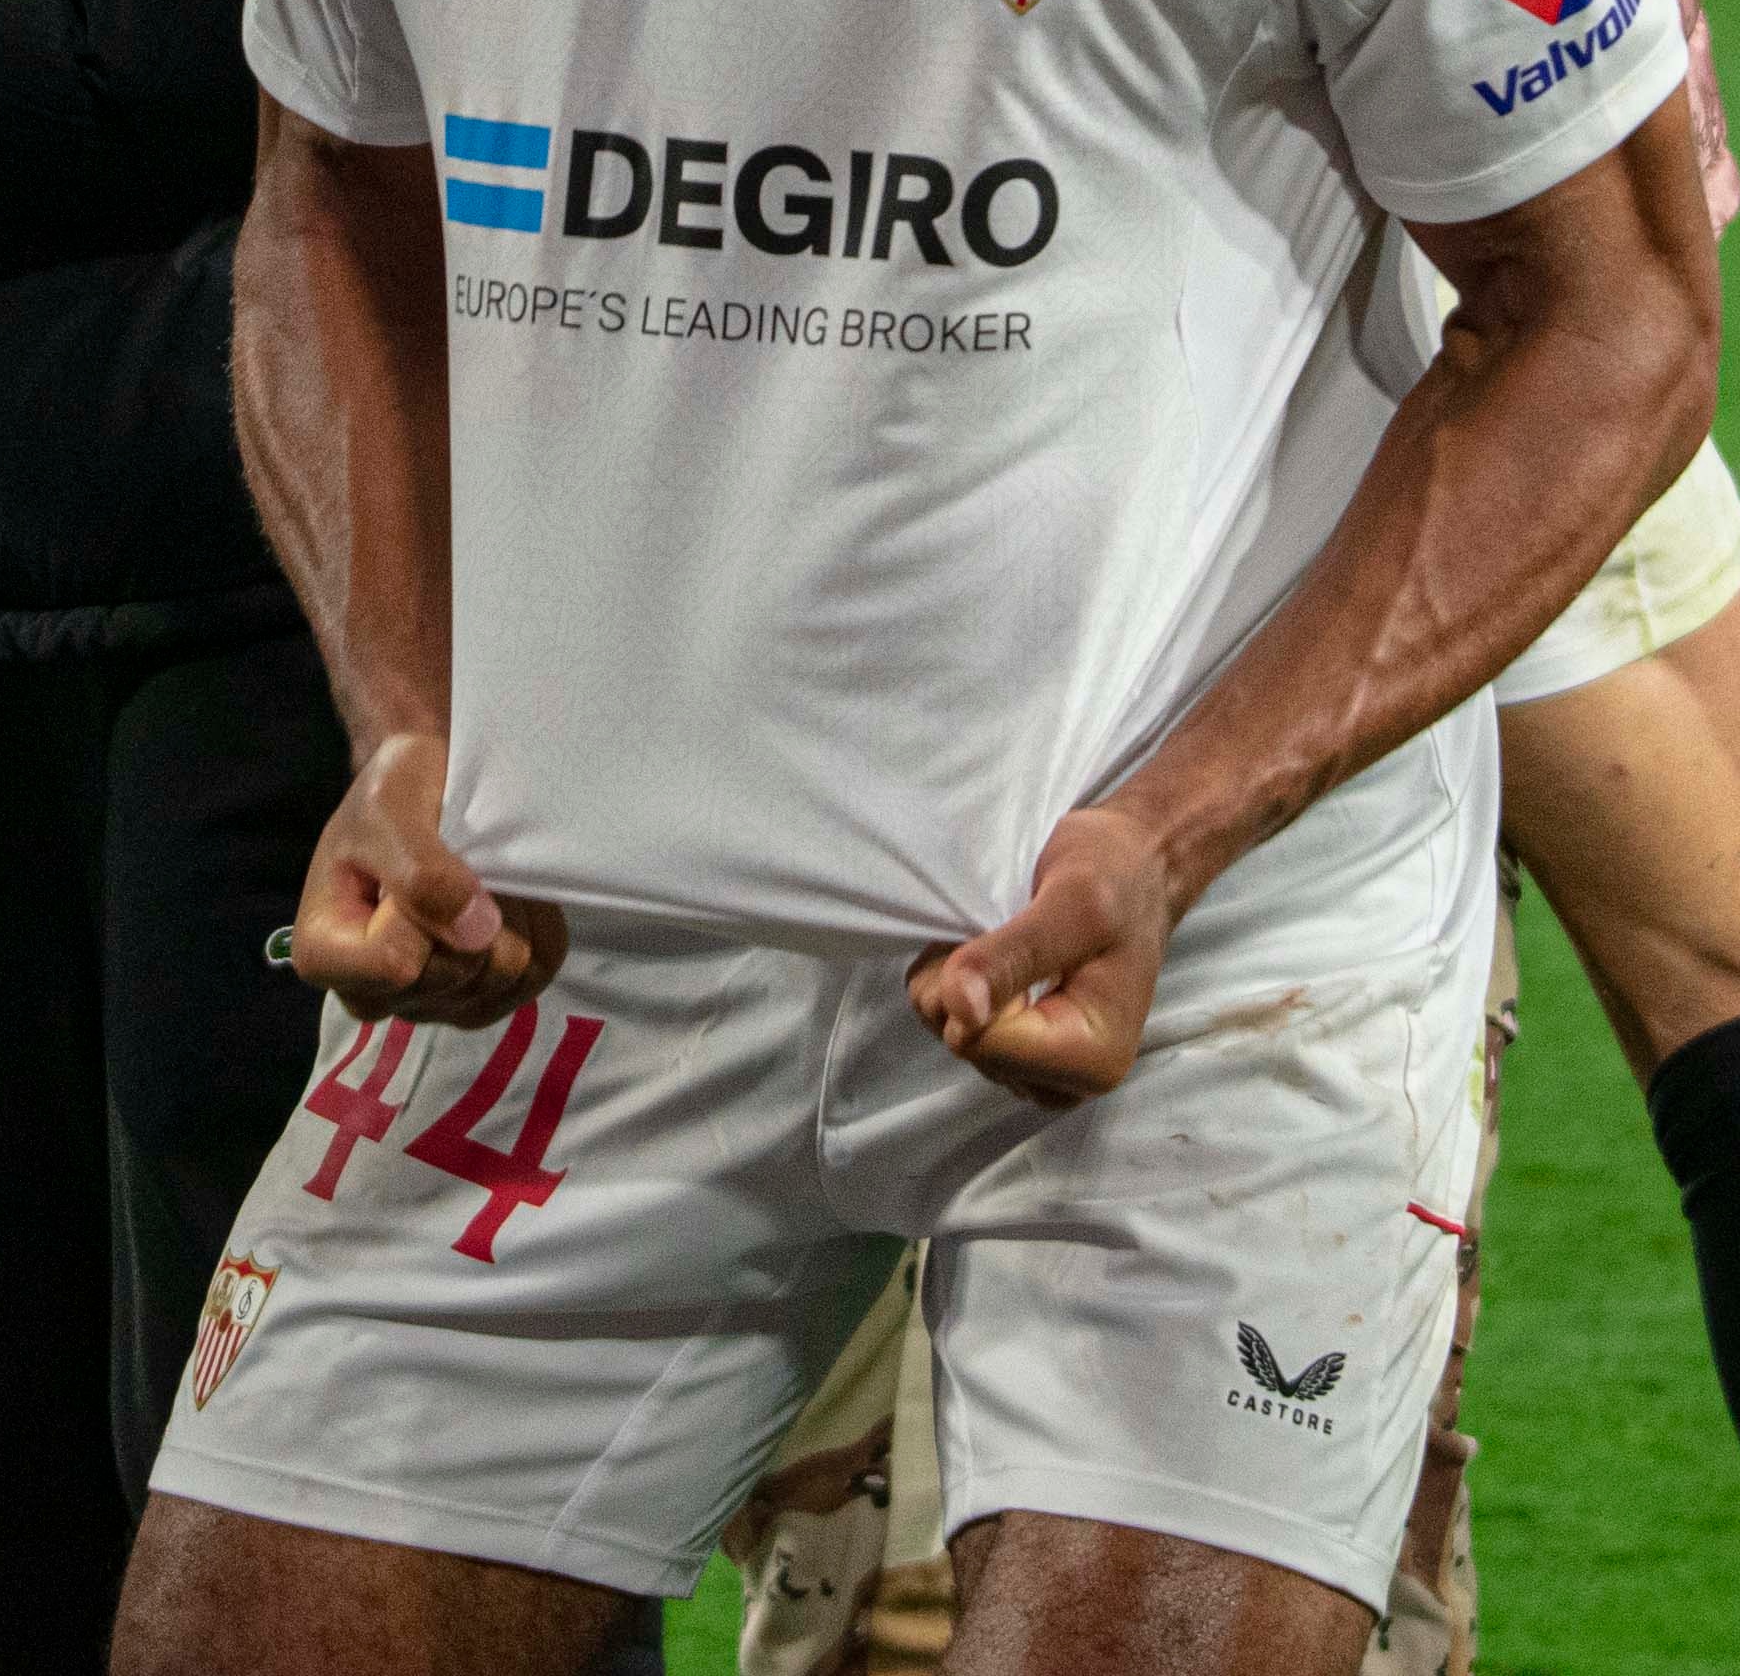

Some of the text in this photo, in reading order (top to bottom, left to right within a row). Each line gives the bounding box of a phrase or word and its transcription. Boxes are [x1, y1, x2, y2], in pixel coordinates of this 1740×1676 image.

[562, 128, 1060, 268] DEGIRO
[640, 294, 830, 349] LEADING
[839, 309, 1034, 355] BROKER
[301, 998, 606, 1264] 44
[1226, 1389, 1335, 1436] CASTORE
